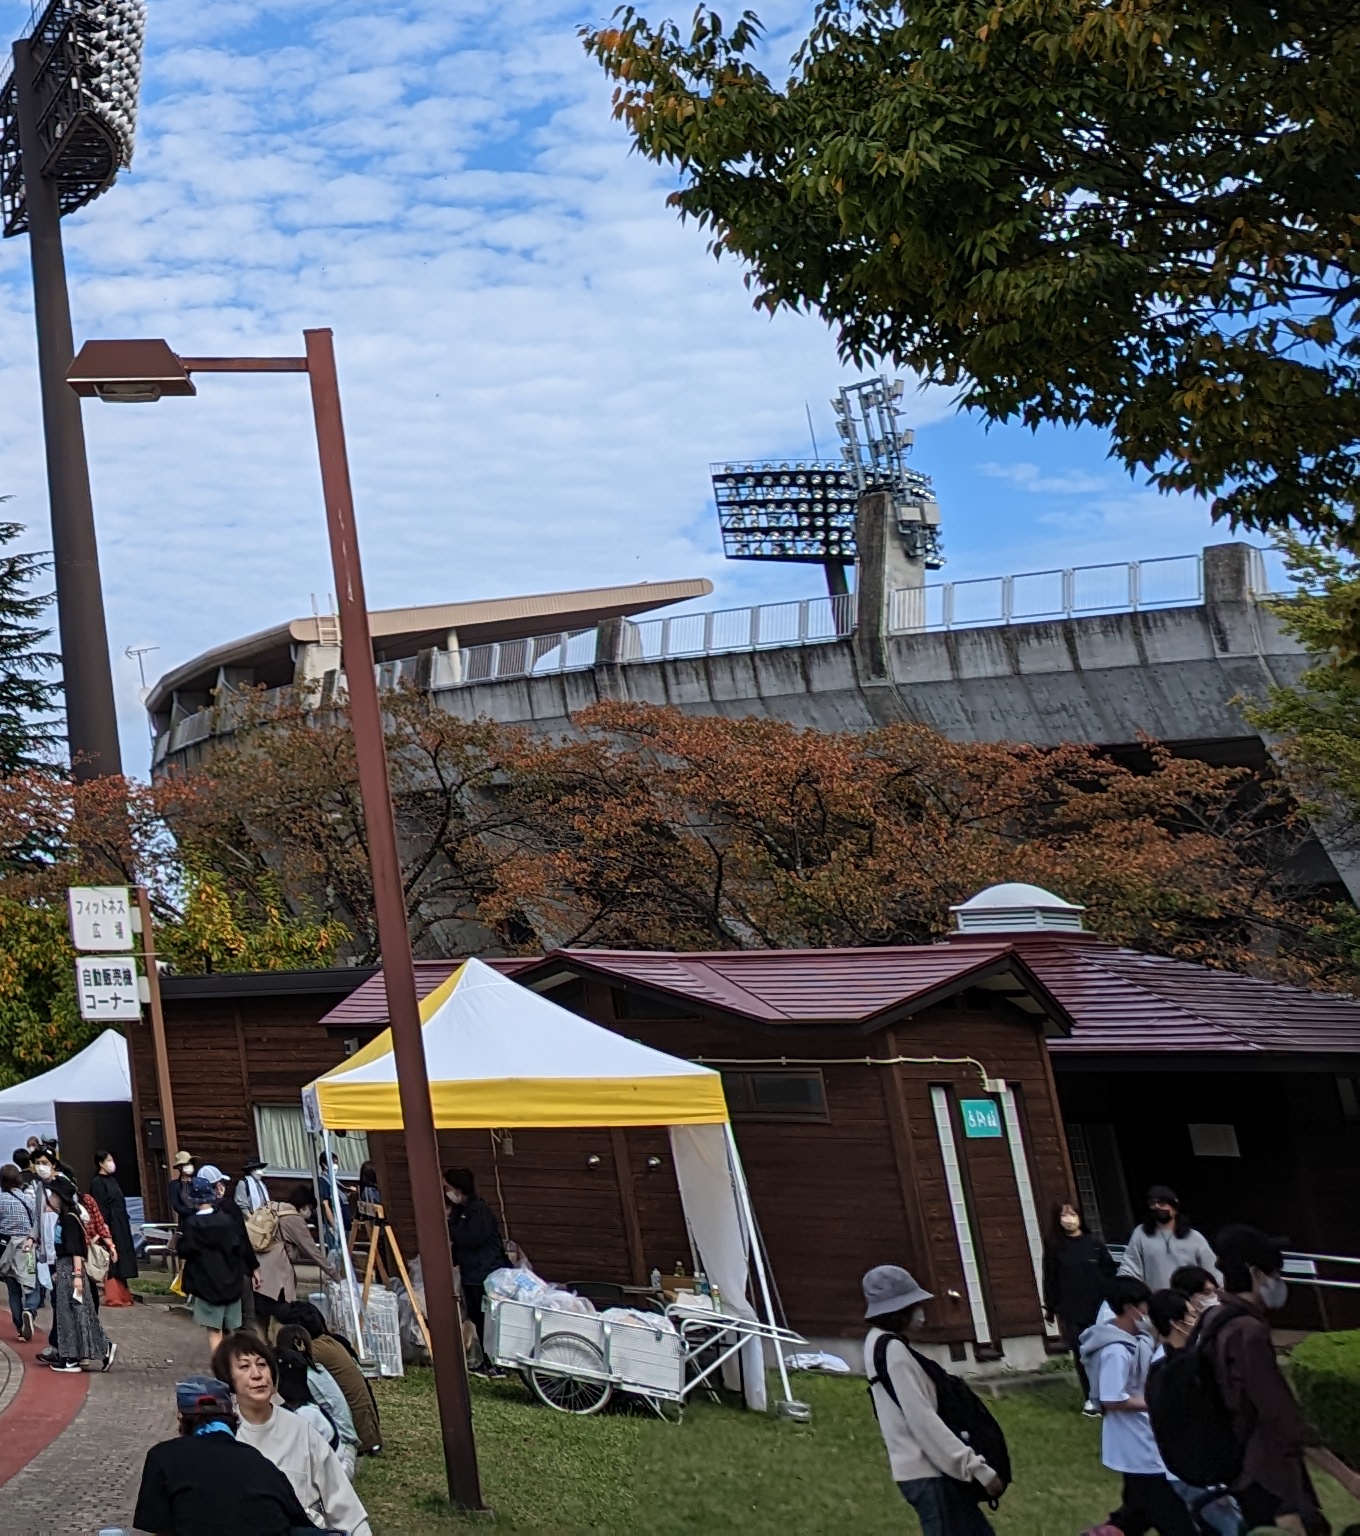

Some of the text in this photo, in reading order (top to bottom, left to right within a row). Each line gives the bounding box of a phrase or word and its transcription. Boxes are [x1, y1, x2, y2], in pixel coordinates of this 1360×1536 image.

[75, 897, 126, 915] フィットネス
[82, 968, 133, 987] 自動販売機
[85, 992, 134, 1010] コーナー
